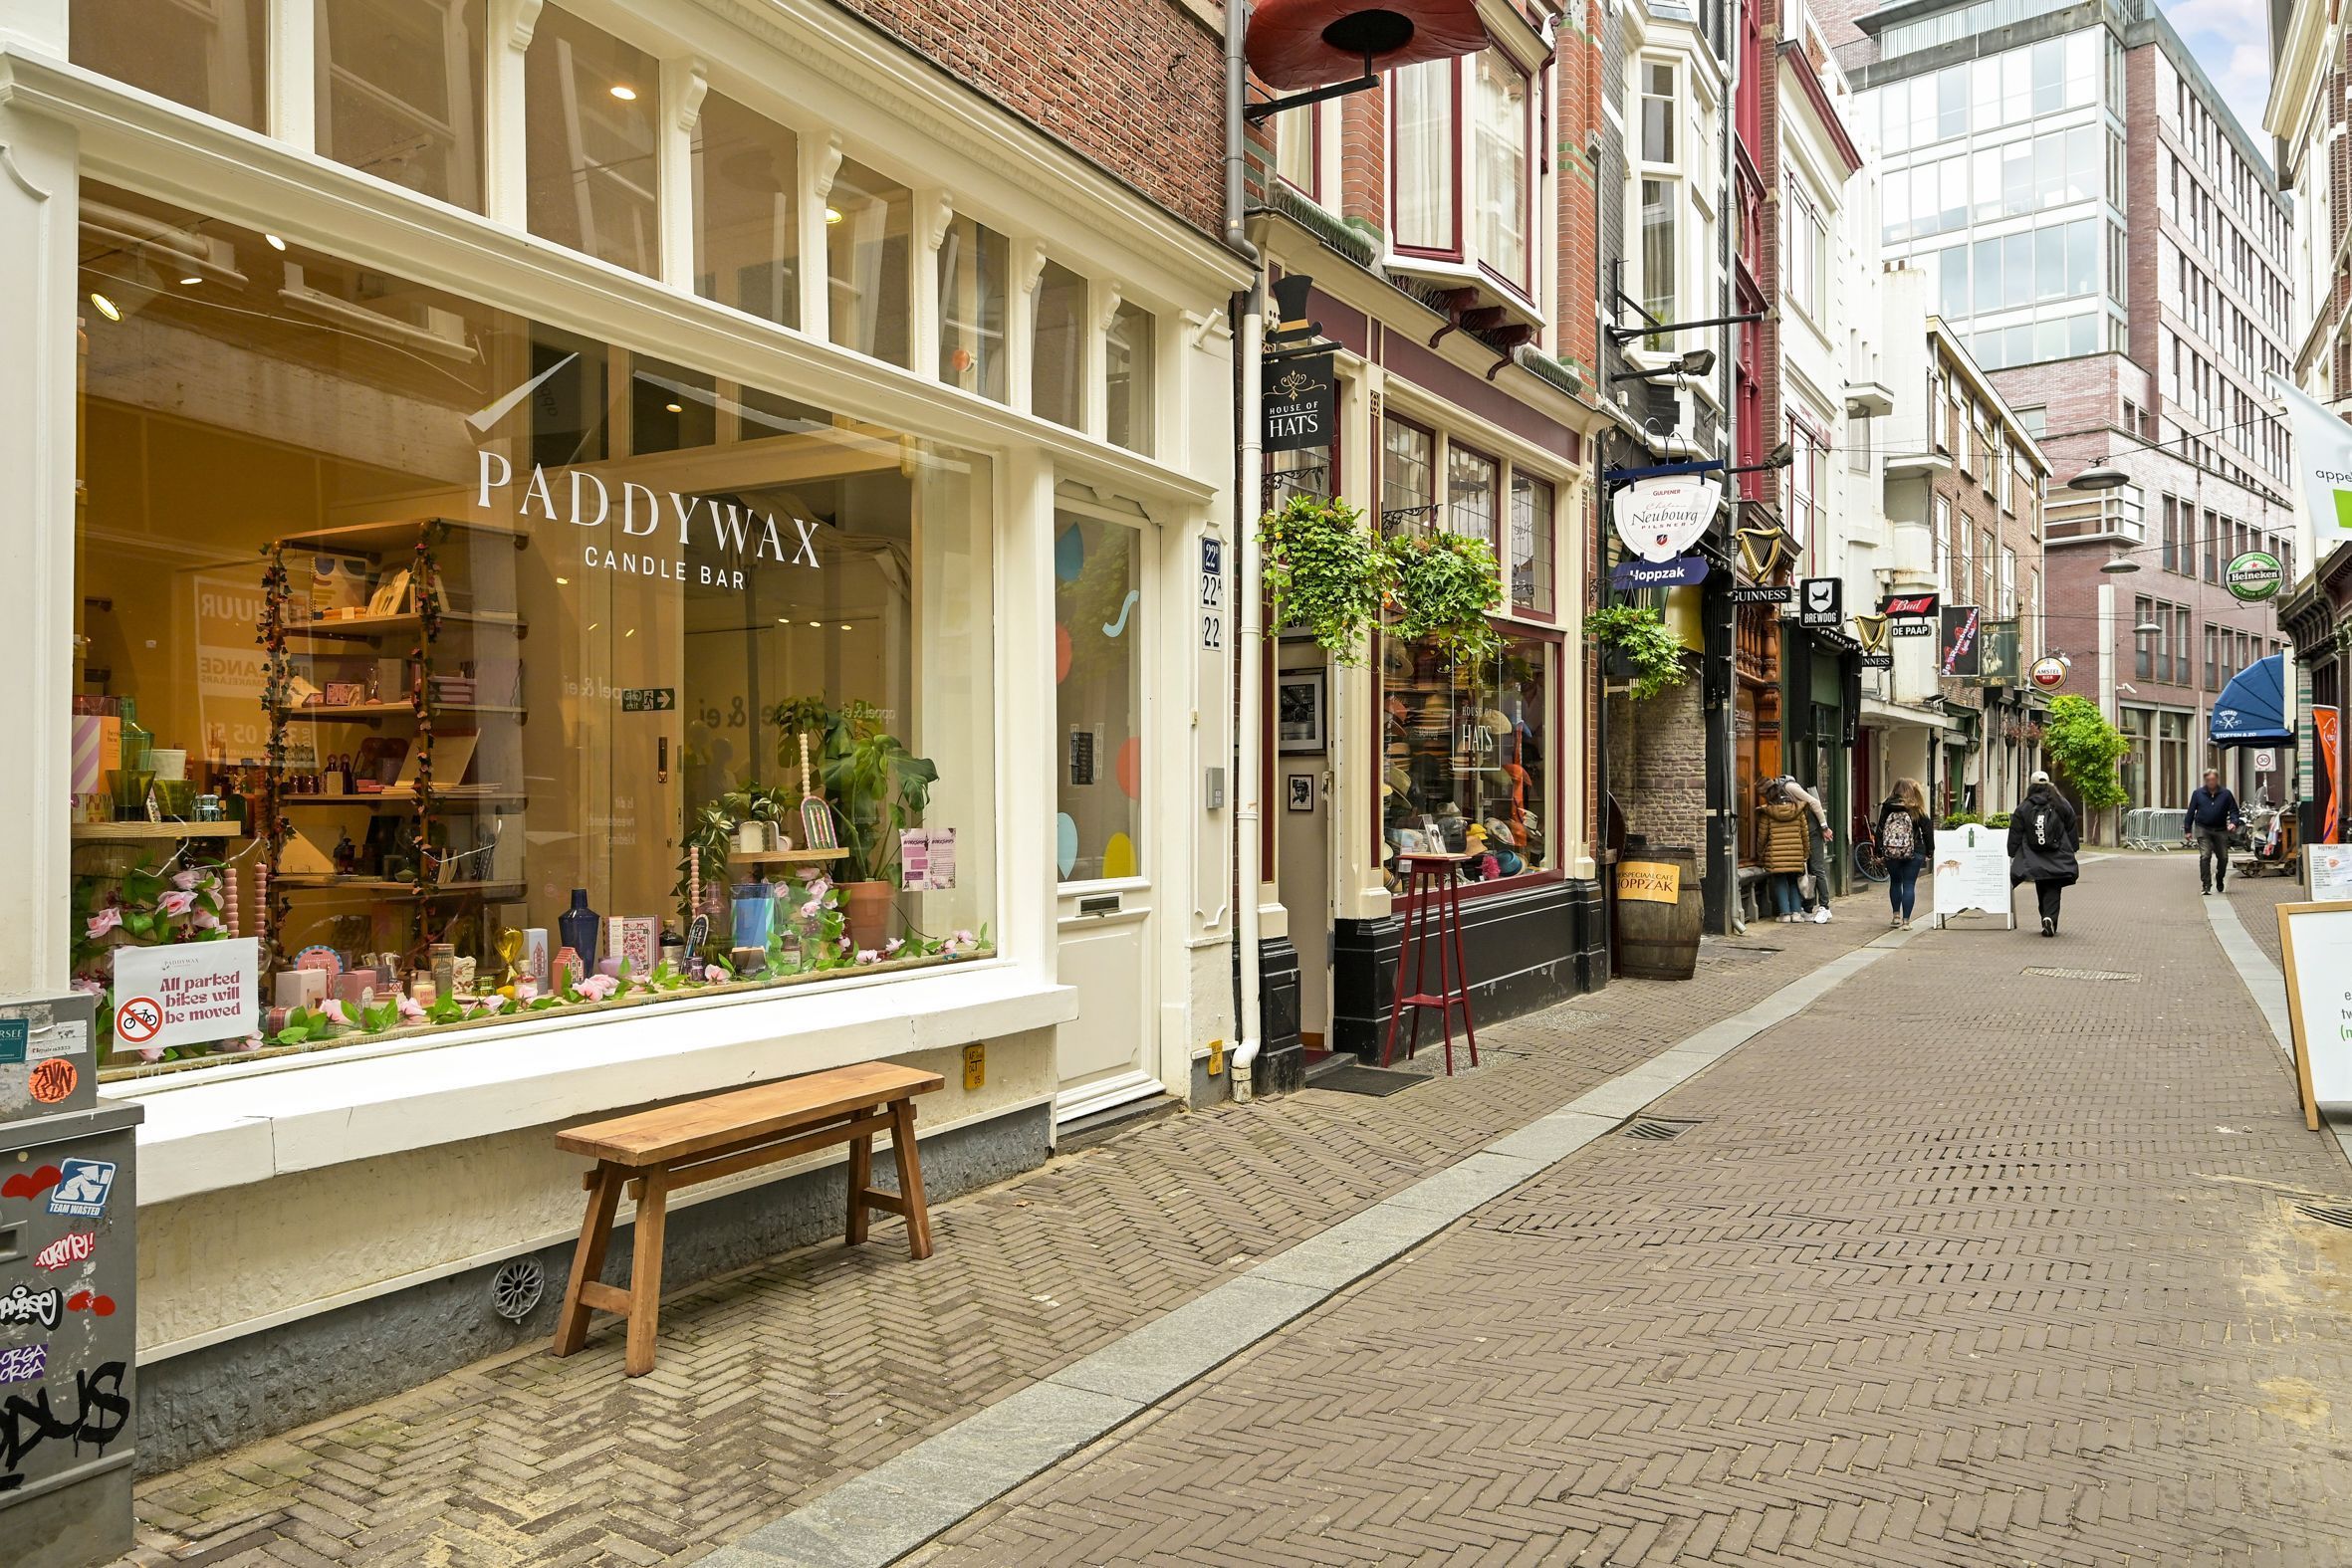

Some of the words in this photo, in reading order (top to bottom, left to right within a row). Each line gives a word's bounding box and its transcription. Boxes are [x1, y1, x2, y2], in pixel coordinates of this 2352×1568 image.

[1270, 403, 1301, 415] HOUSE
[1306, 400, 1318, 409] OF
[1269, 413, 1318, 438] HATS
[477, 450, 821, 568] PADDYWAX
[1631, 508, 1699, 526] Neubourg
[585, 547, 686, 580] CANDLE
[701, 565, 745, 590] BAR
[1630, 566, 1686, 582] Hoppzak
[2232, 570, 2277, 582] Heineken
[1203, 574, 1222, 606] 22A
[1733, 588, 1788, 602] GUINNESS
[1893, 599, 1922, 611] Bud
[1804, 611, 1838, 624] BREWDOG
[1204, 615, 1220, 648] 22
[1892, 626, 1904, 636] DE
[1905, 625, 1929, 636] PAAP
[1861, 657, 1890, 666] INNESS
[1462, 724, 1493, 752] HATS
[2034, 814, 2046, 845] adidas
[160, 977, 180, 993] All
[184, 970, 240, 994] parked
[165, 992, 208, 1008] bikes
[212, 986, 240, 1002] will
[165, 1010, 185, 1024] be
[189, 1002, 241, 1021] moved
[49, 1203, 70, 1215] TEAM
[70, 1205, 101, 1217] WASTED
